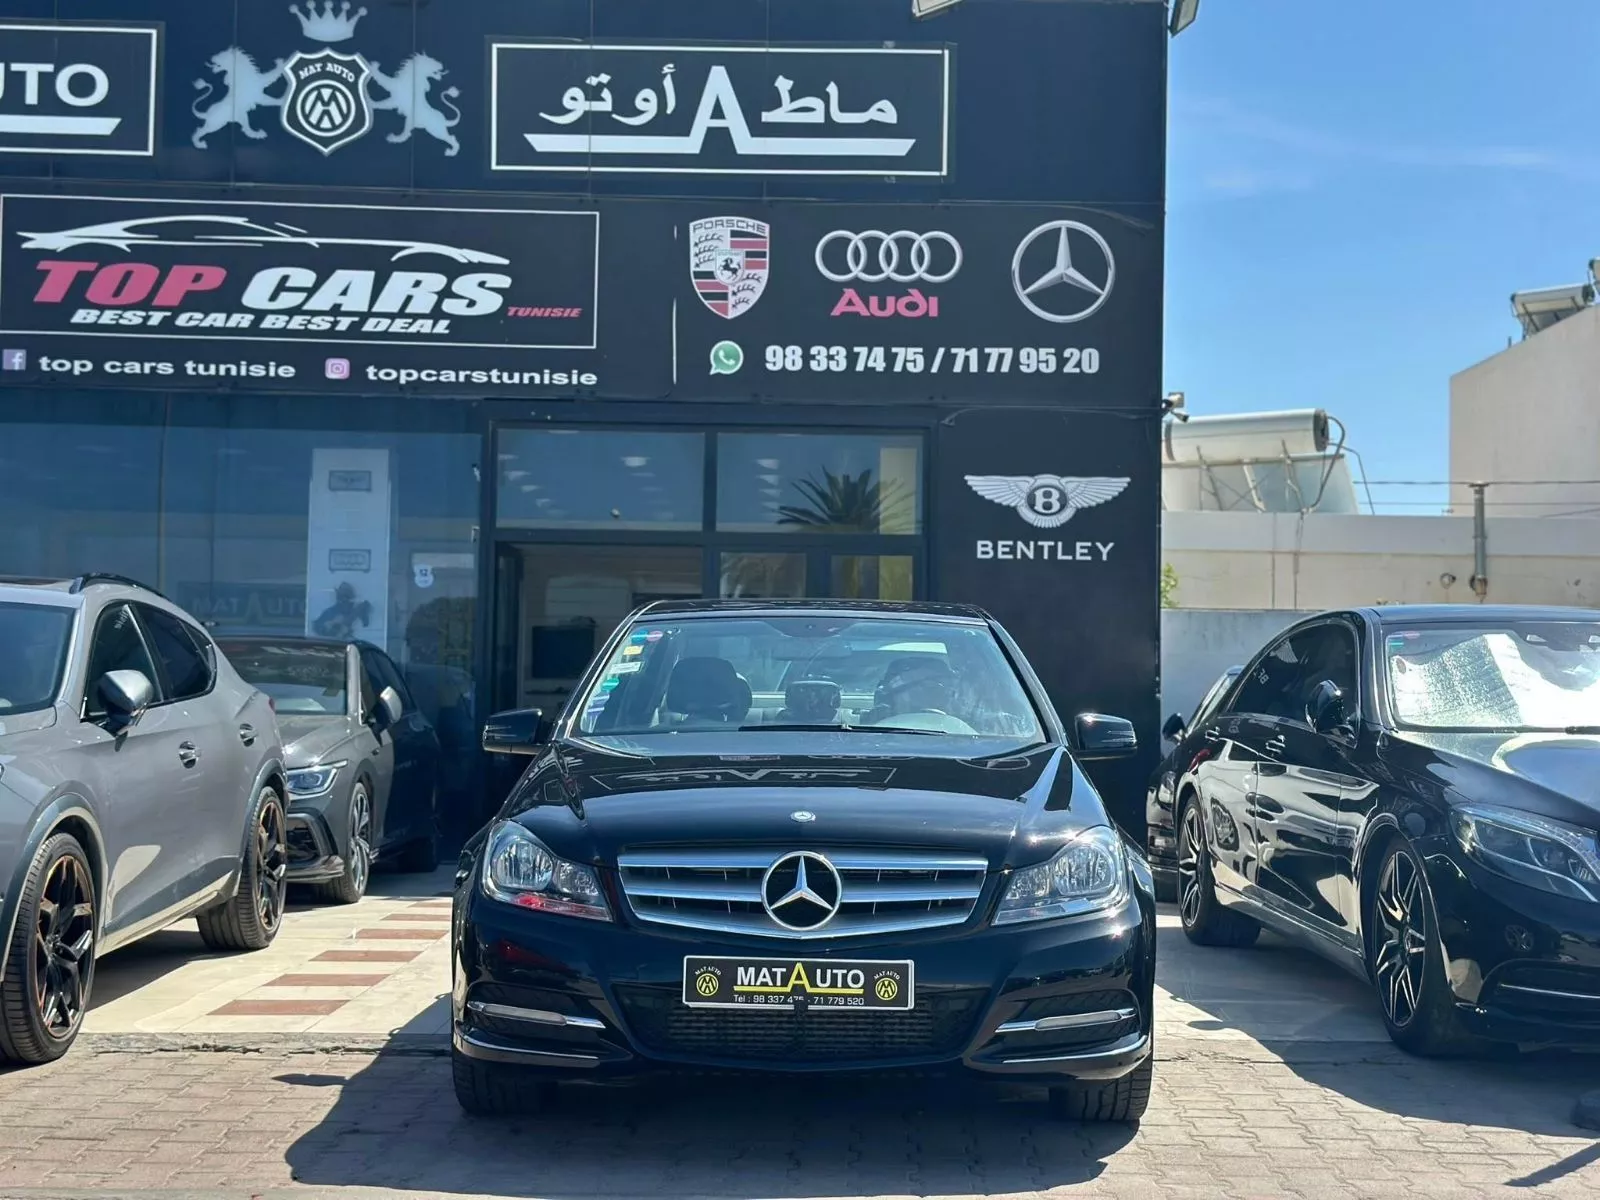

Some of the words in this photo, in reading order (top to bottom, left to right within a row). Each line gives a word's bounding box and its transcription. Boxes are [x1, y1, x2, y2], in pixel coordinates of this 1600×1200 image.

[0, 62, 109, 107] TO
[299, 62, 323, 80] MAT
[326, 62, 355, 82] AUTO
[539, 63, 677, 126] أوتو
[761, 74, 898, 125] ماط
[693, 219, 766, 235] PORSCHE
[34, 260, 227, 306] TOP
[241, 267, 512, 316] CARS
[507, 306, 583, 318] TUNISIE
[830, 288, 939, 318] Audi
[70, 308, 172, 328] BEST
[174, 311, 256, 329] CAR
[259, 314, 360, 331] BEST
[361, 317, 451, 335] DEAL
[39, 356, 94, 376] top
[103, 360, 175, 375] cars
[184, 360, 296, 378] tunisie
[765, 345, 803, 372] 98
[809, 345, 848, 372] 33
[853, 346, 887, 373] 74
[890, 346, 925, 373] 75
[930, 346, 946, 374] /
[950, 347, 980, 374] 71
[983, 347, 1014, 374] 77
[1018, 347, 1057, 374] 95
[1062, 347, 1100, 374] 20
[365, 365, 598, 386] topcarstunisie
[976, 539, 1115, 562] BENTLEY
[737, 966, 787, 986] MAT
[753, 994, 765, 1003] 98
[767, 995, 785, 1004] 337
[813, 996, 824, 1004] 71
[827, 997, 845, 1005] 779
[846, 997, 865, 1006] 520
